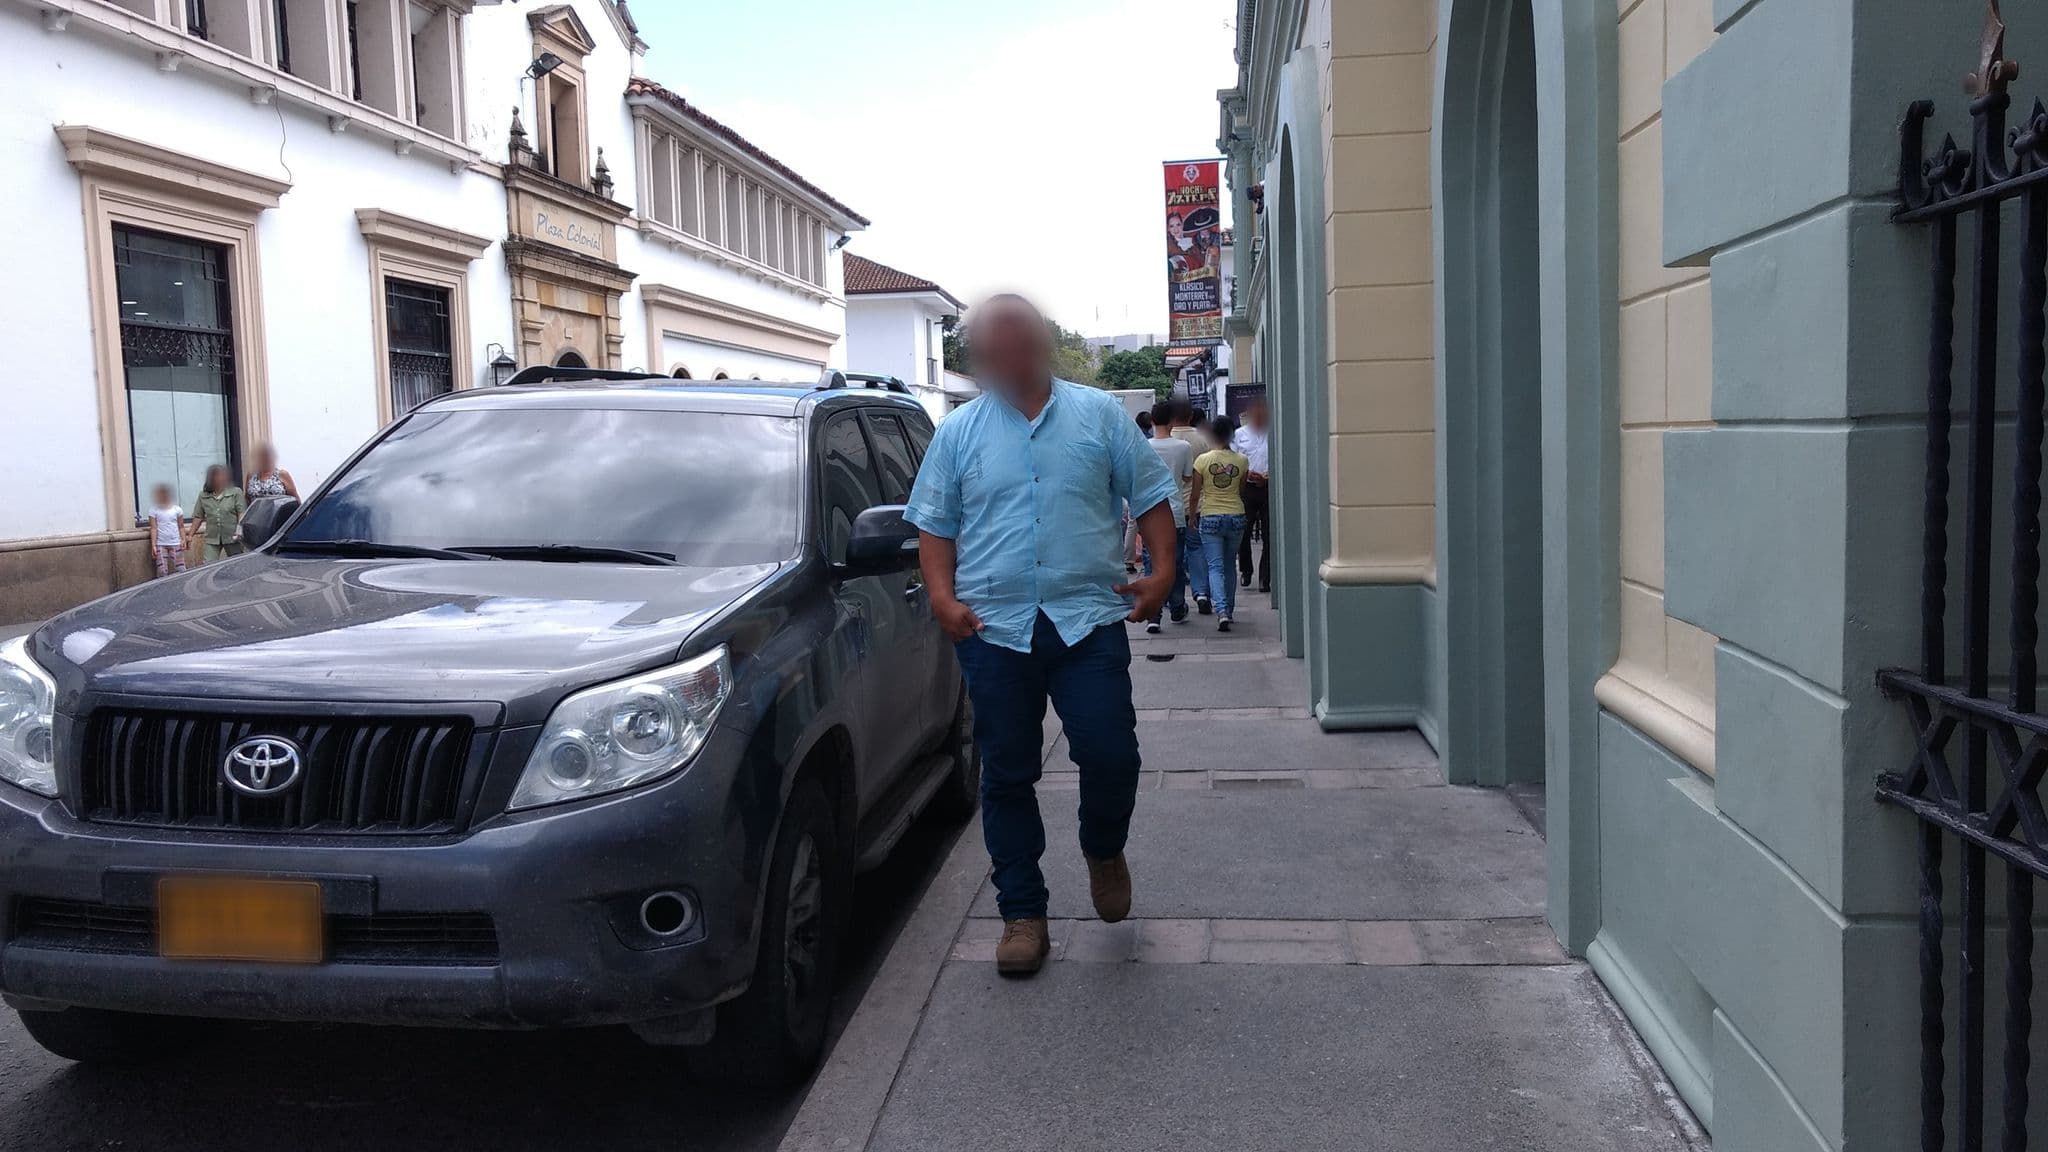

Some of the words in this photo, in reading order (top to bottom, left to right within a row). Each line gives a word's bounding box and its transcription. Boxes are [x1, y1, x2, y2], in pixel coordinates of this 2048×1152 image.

[537, 212, 564, 239] Plaza
[567, 224, 601, 250] Colonial
[1180, 282, 1204, 291] KLASICO
[1174, 292, 1208, 300] MONTERREY
[1174, 301, 1186, 311] ORO
[1187, 301, 1191, 310] Y
[1192, 301, 1210, 310] PLATA
